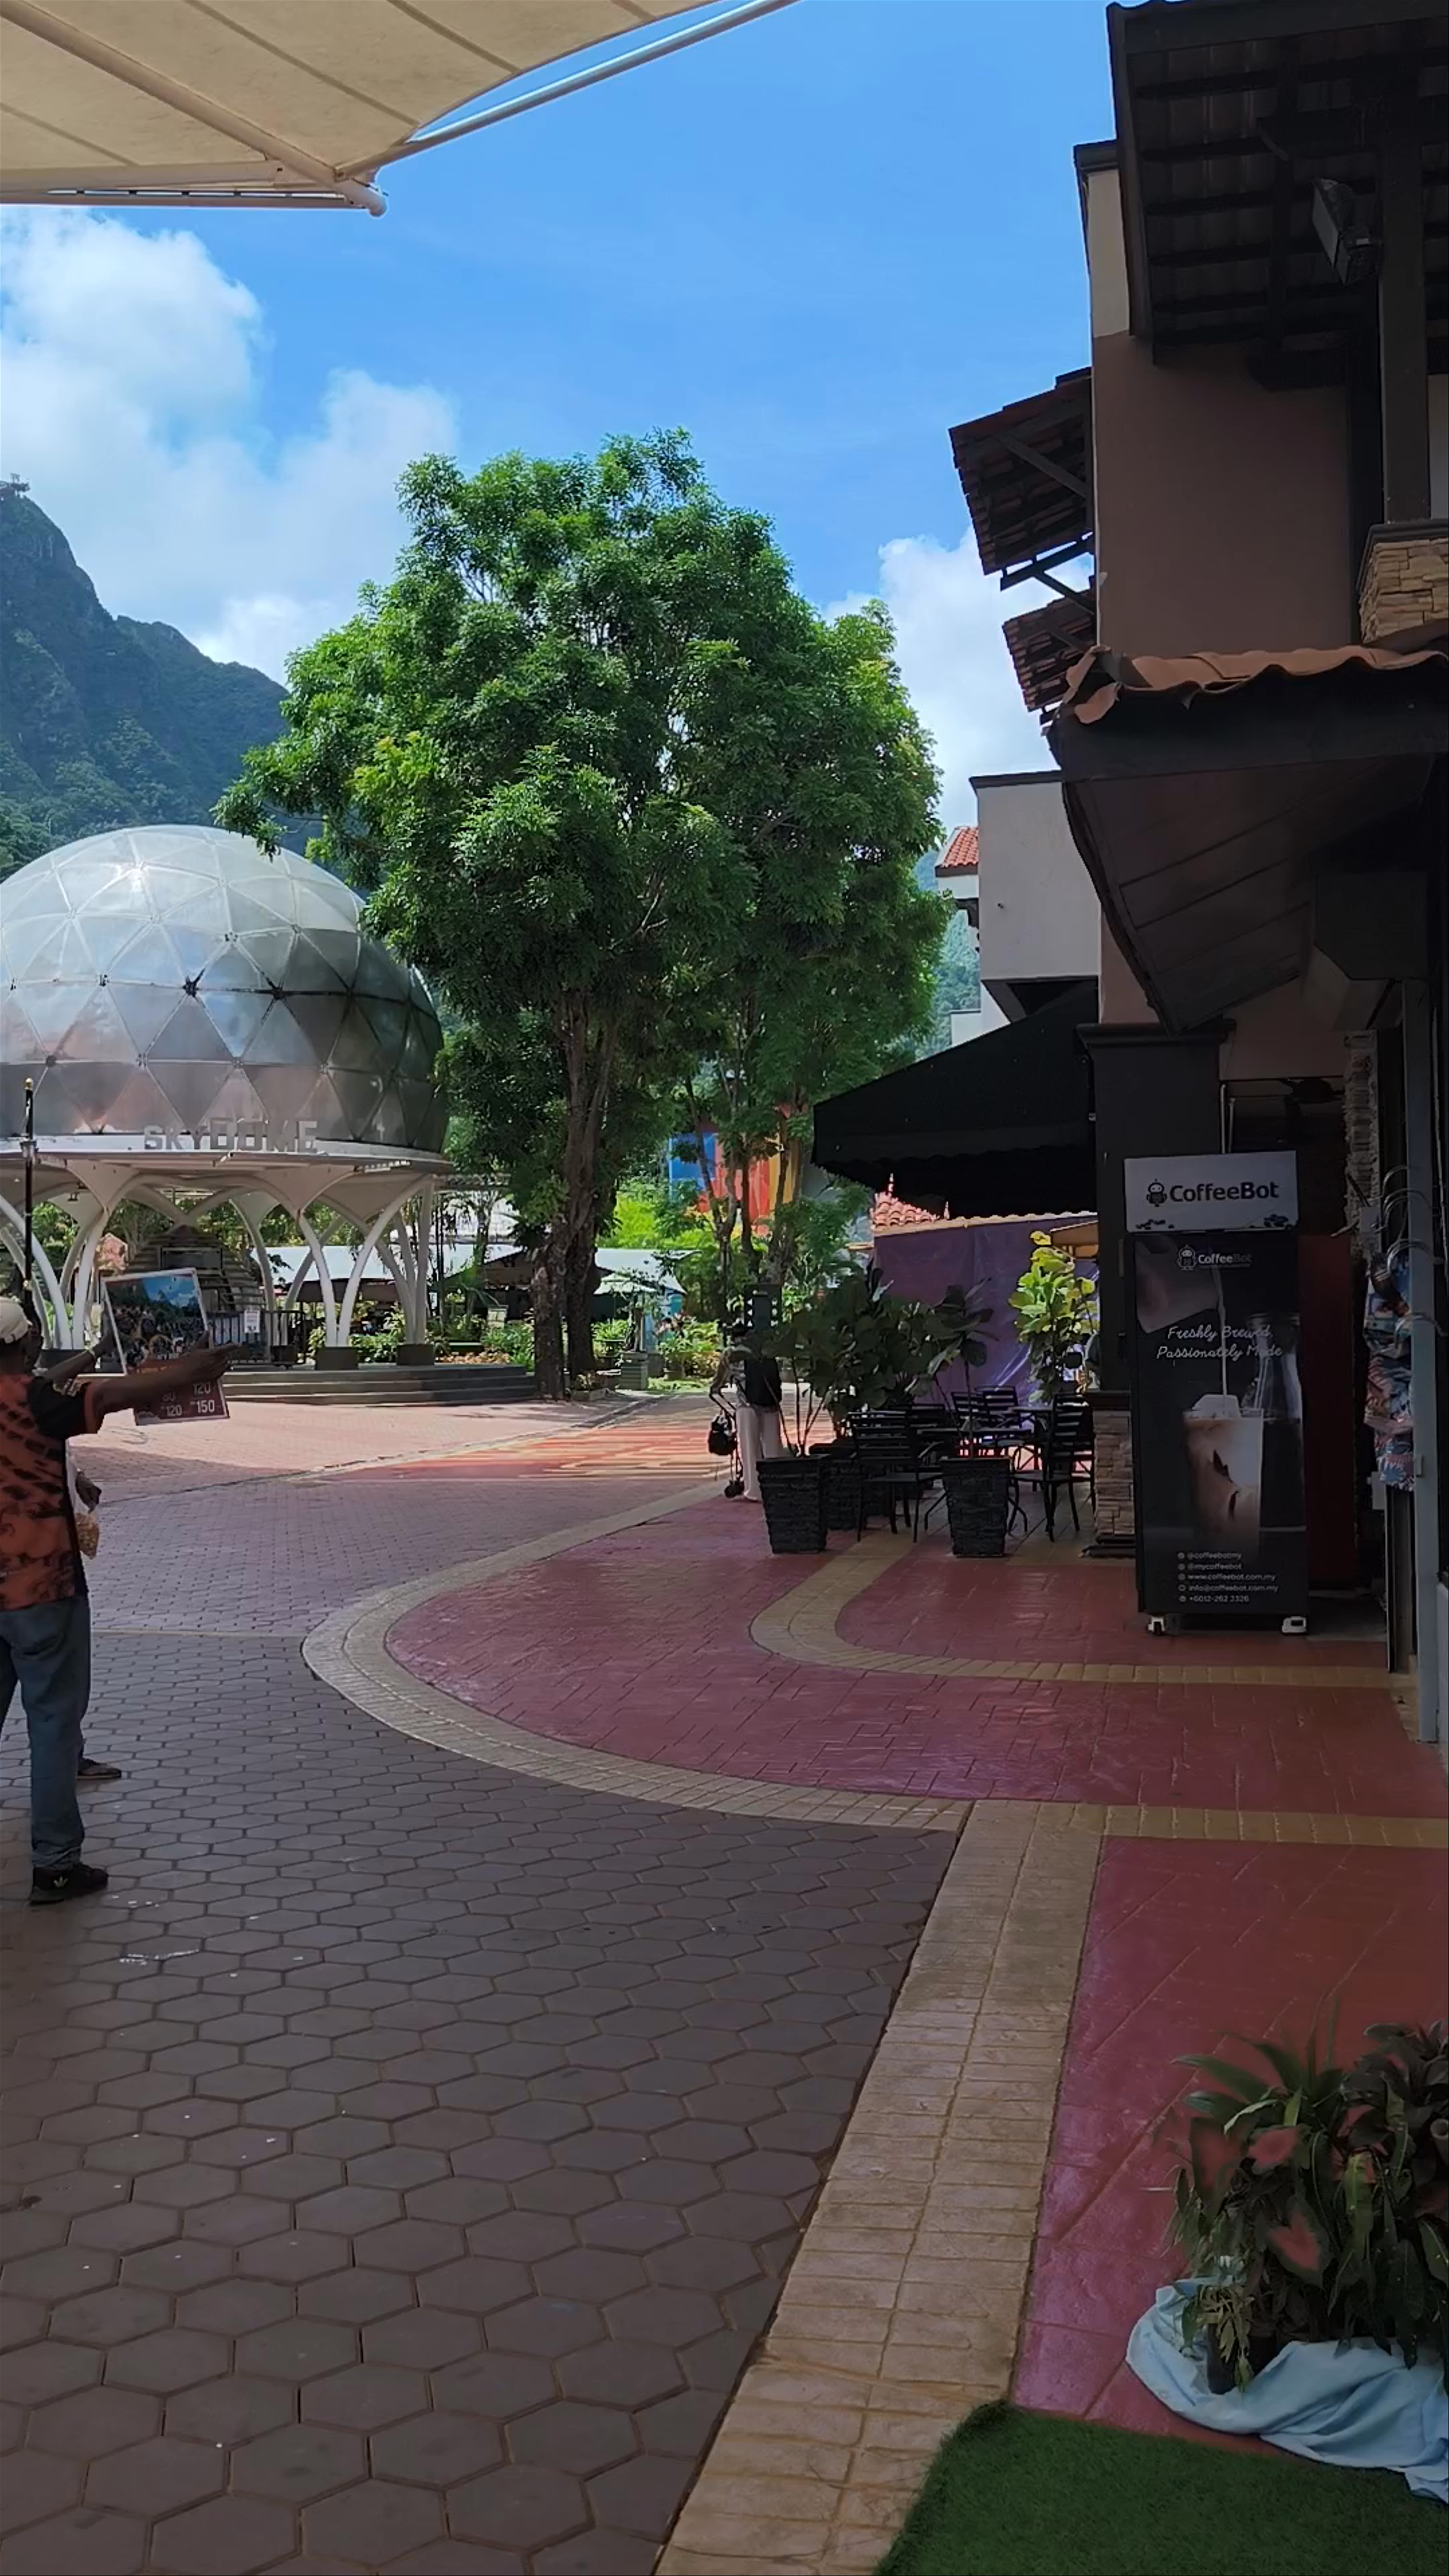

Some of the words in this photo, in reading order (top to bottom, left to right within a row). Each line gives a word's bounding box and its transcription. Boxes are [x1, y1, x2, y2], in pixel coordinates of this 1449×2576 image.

[144, 1117, 318, 1152] SKYDOME
[1170, 1181, 1279, 1203] CoffeeBot
[1198, 1253, 1252, 1264] CoffeeBot
[1167, 1324, 1218, 1342] Freshly
[1156, 1343, 1244, 1361] Passionately
[196, 1400, 215, 1413] 150
